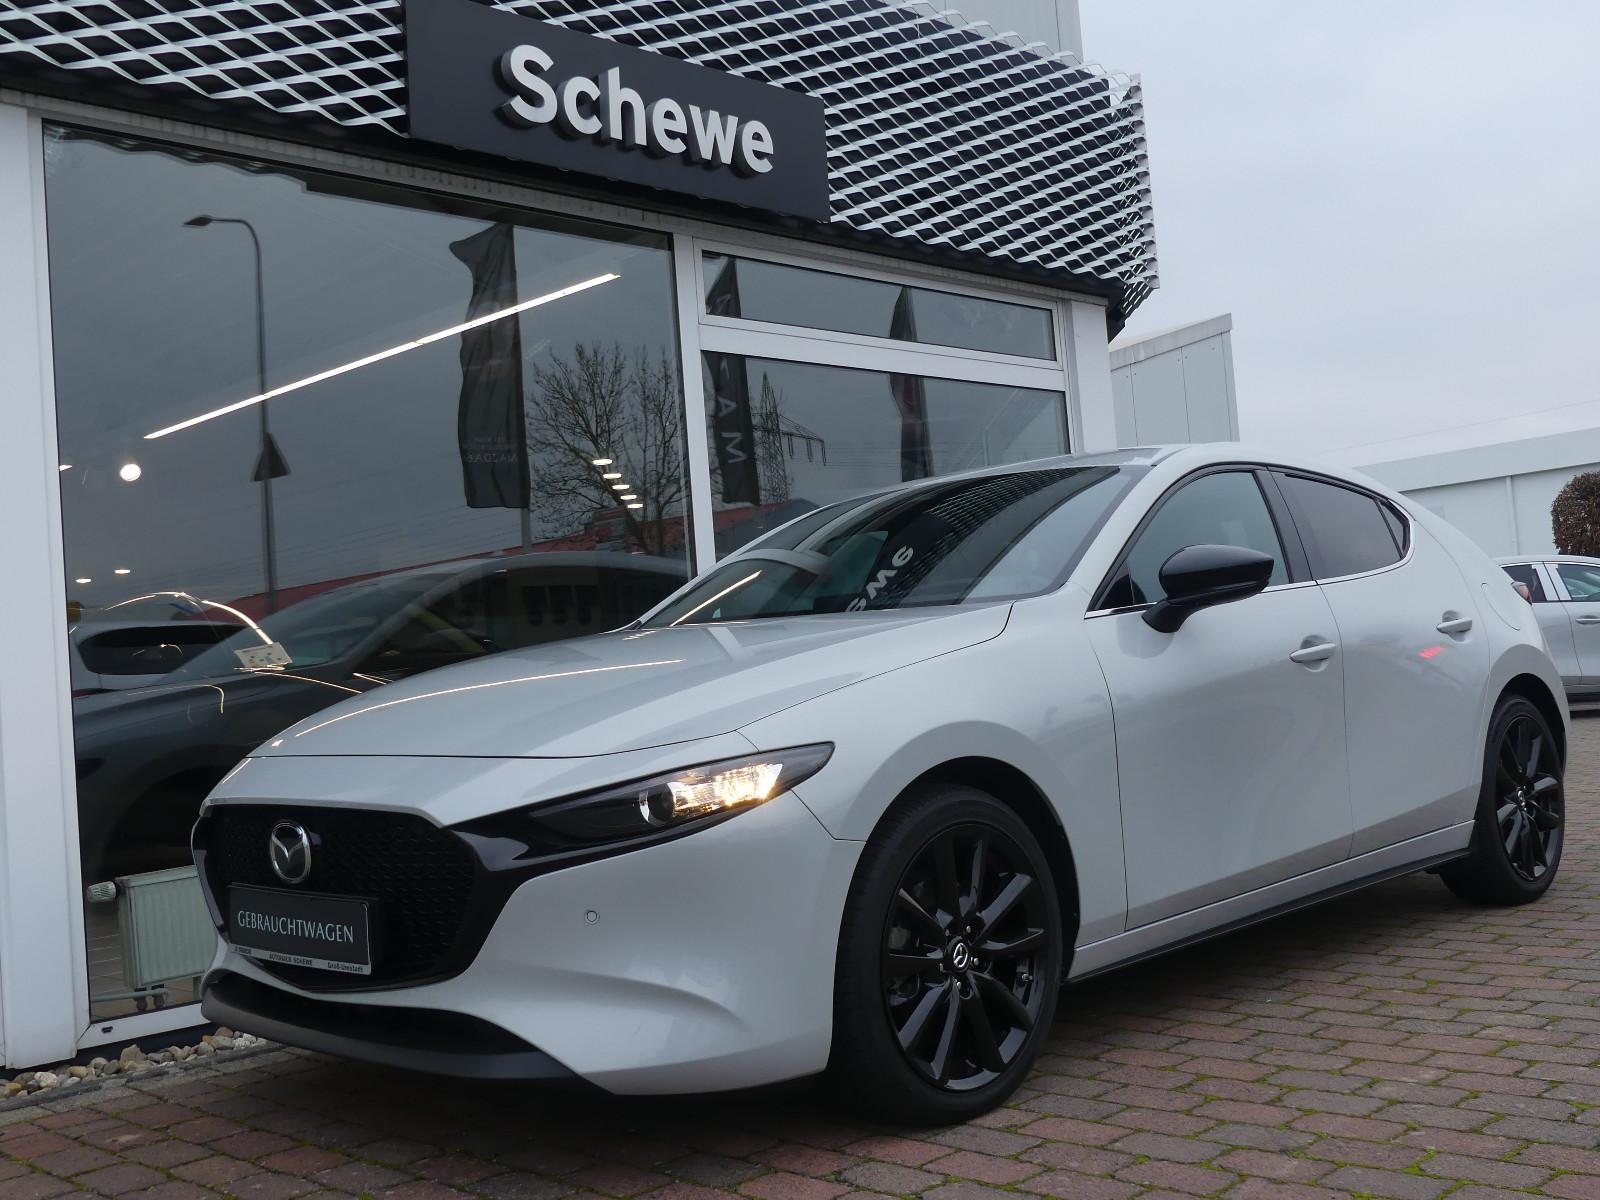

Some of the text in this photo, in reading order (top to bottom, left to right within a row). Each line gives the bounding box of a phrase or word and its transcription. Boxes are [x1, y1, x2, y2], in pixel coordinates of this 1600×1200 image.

[503, 44, 774, 174] Schewe
[237, 910, 354, 944] GEBRAUCHTWAGEN
[293, 956, 313, 966] SCHEWE
